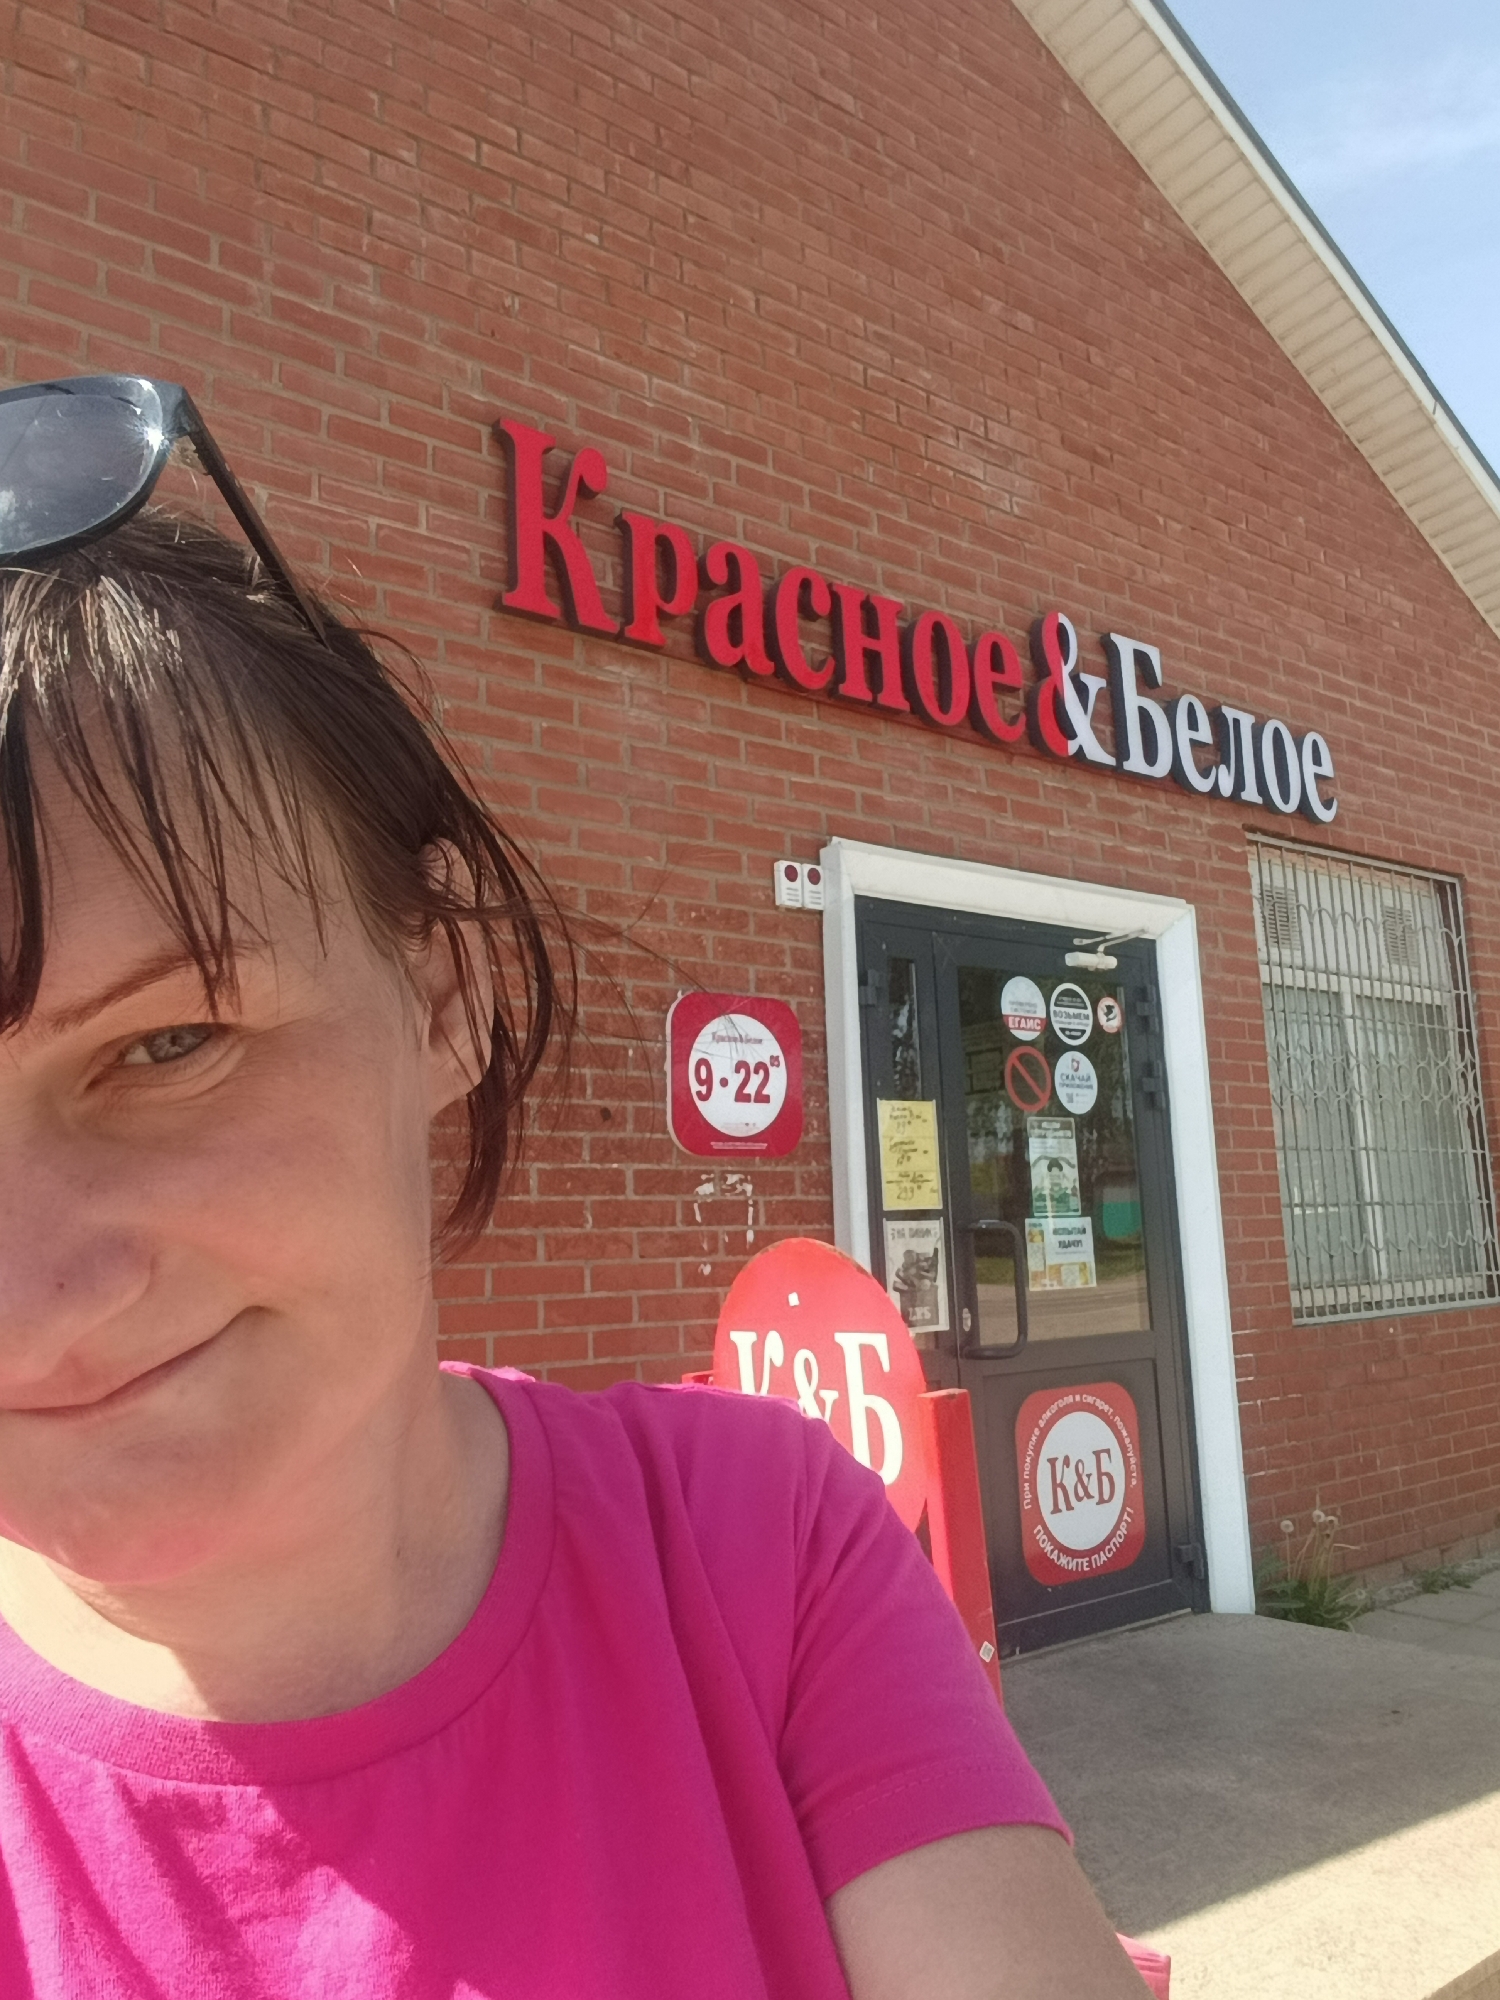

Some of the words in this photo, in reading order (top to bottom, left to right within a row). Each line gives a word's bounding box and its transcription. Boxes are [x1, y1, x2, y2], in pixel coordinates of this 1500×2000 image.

[1008, 1016, 1041, 1030] ЕГАИС
[1023, 1427, 1040, 1479] покупке
[1038, 1394, 1074, 1428] алкоголя
[1074, 1394, 1081, 1402] и
[1046, 1448, 1116, 1515] К&Б
[1033, 1524, 1091, 1572] ПОКАЖИТЕ
[1091, 1506, 1135, 1569] ПАСПОРТ!
